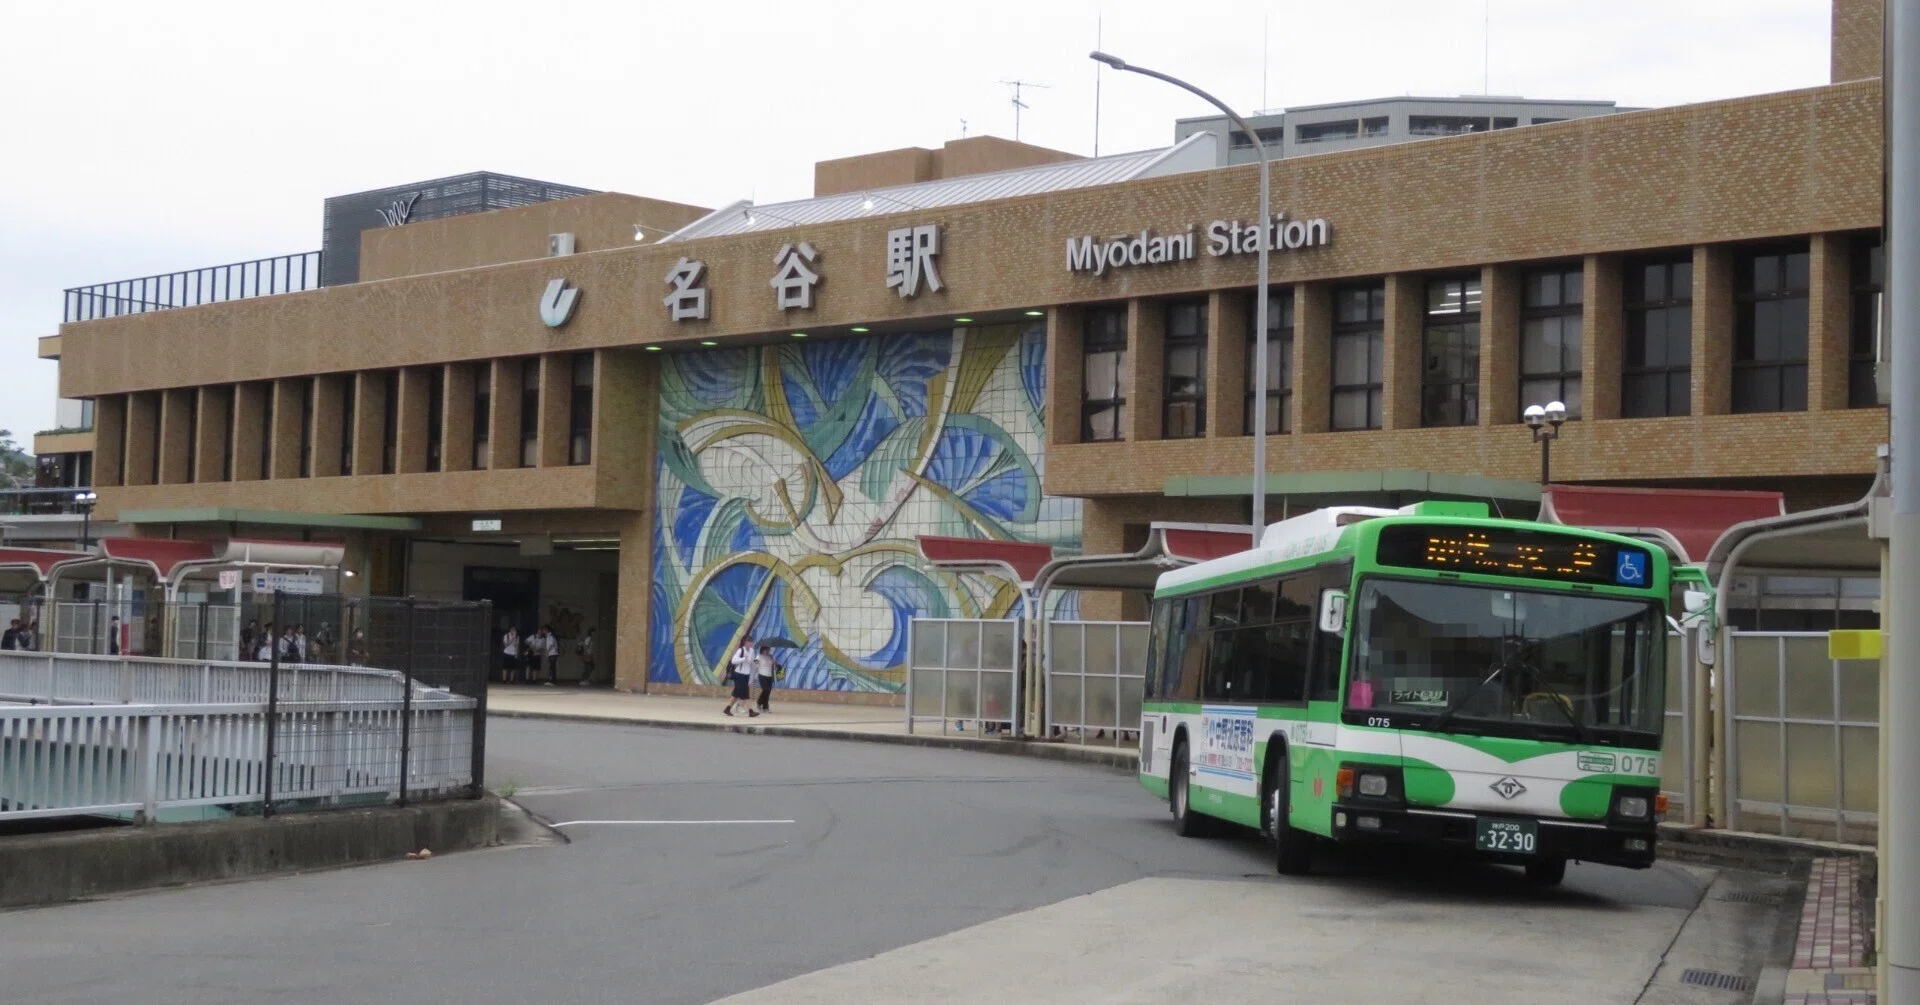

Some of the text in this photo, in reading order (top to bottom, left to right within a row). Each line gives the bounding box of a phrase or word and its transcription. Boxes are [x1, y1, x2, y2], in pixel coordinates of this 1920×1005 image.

[1207, 213, 1328, 256] Station
[663, 224, 943, 321] 名谷駅
[1368, 717, 1391, 728] 075
[1621, 755, 1656, 774] 075
[1487, 830, 1534, 851] 32-90
